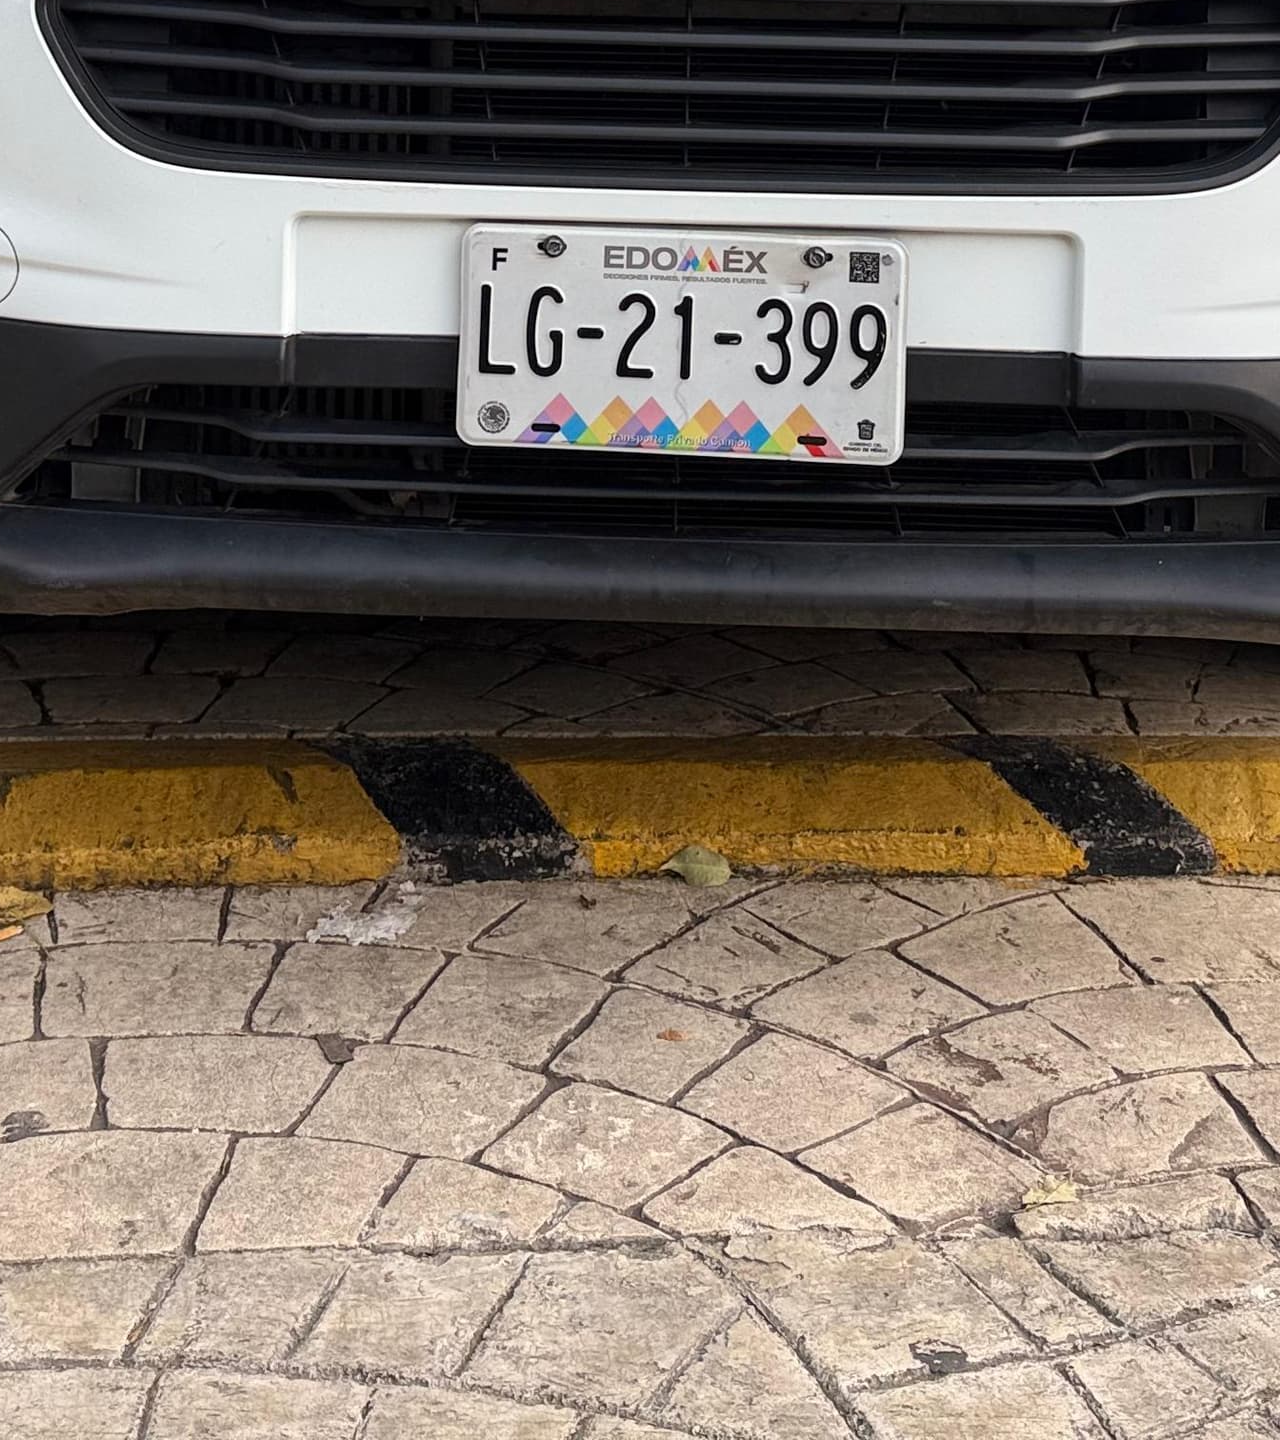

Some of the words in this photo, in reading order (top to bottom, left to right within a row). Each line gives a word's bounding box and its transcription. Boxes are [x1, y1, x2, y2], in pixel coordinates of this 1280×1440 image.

[491, 247, 509, 272] F
[478, 283, 889, 391] LG-21-399
[607, 431, 665, 445] Transporte
